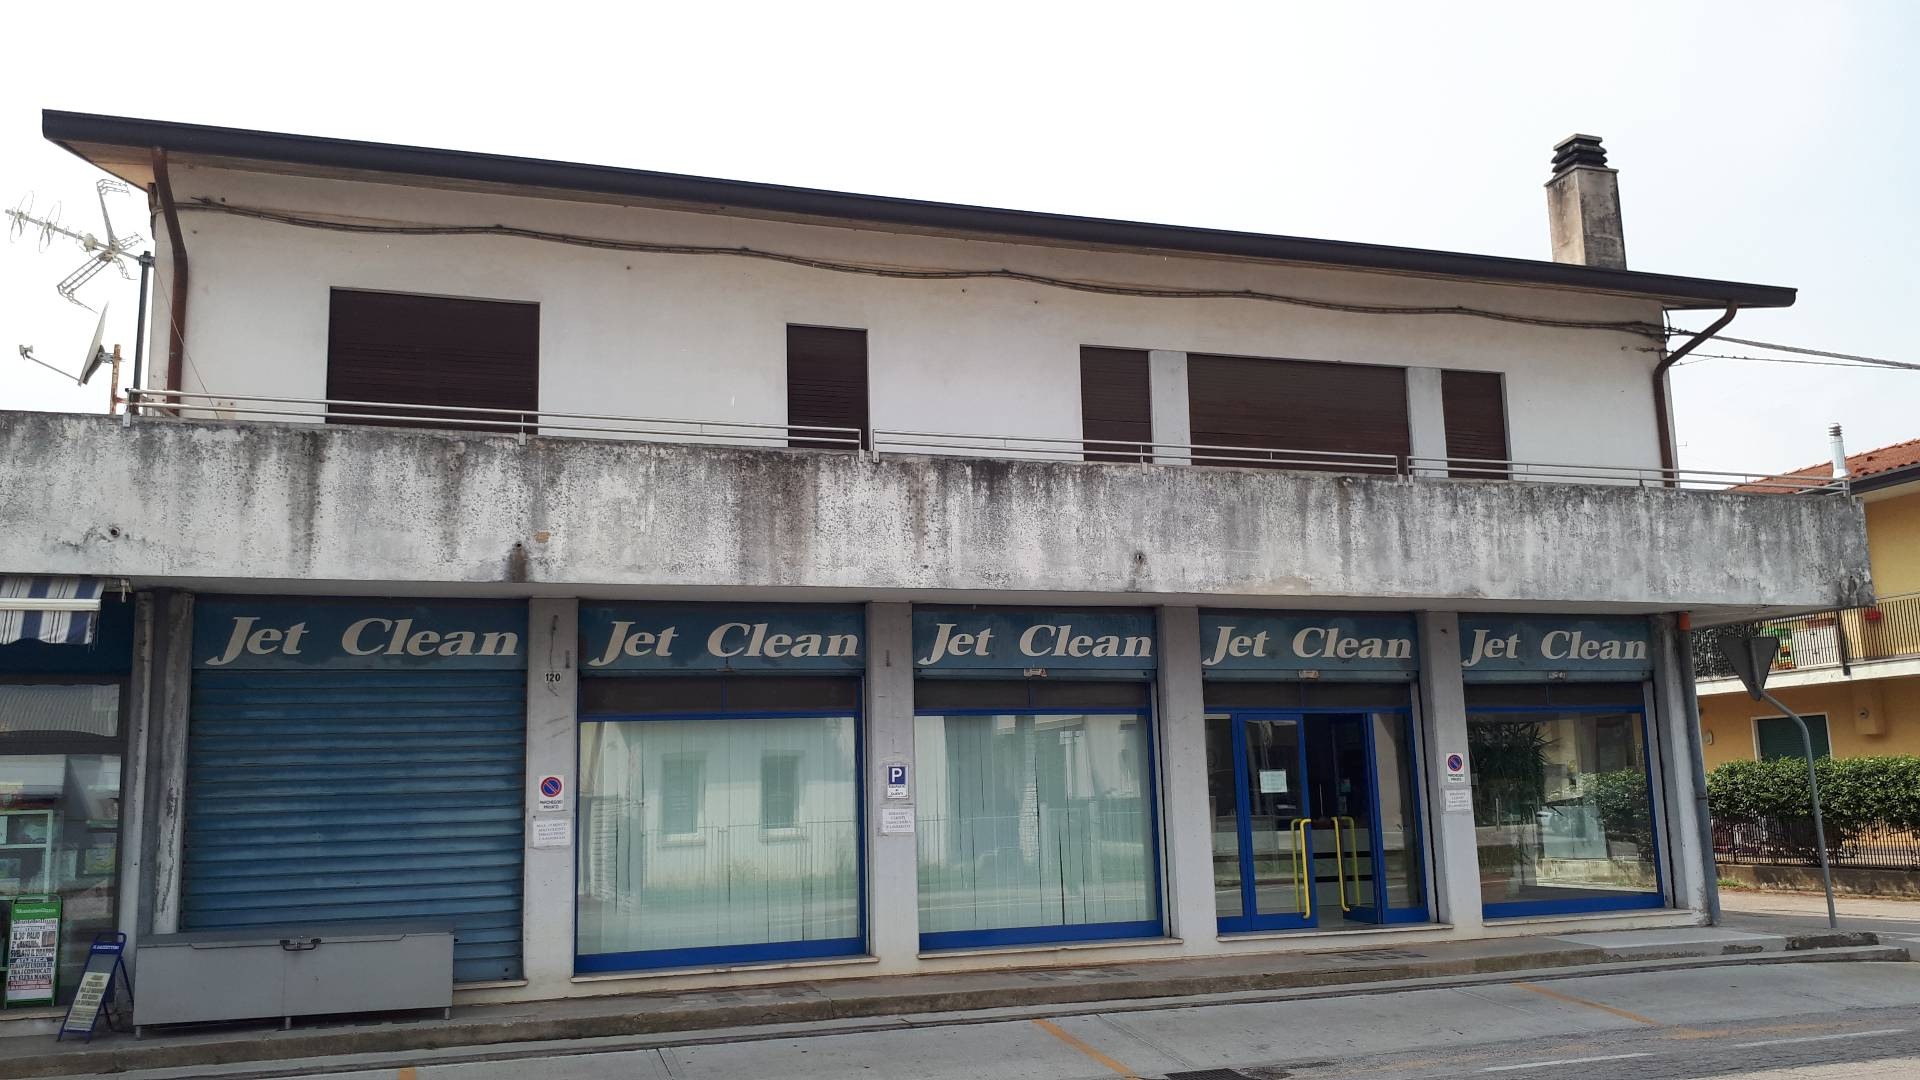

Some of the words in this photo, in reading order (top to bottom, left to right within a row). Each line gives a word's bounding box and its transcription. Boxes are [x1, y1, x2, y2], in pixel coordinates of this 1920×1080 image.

[205, 616, 310, 666] Jet
[342, 617, 518, 656] Clean
[588, 621, 680, 667] Jet
[707, 622, 859, 657] Clean
[918, 623, 995, 666] Jet
[1019, 624, 1153, 657] Clean
[1202, 626, 1270, 666] Jet
[1292, 627, 1412, 658] Clean
[1462, 629, 1522, 667] Jet
[1540, 630, 1647, 660] Clean
[545, 673, 561, 682] 120
[891, 768, 903, 783] P
